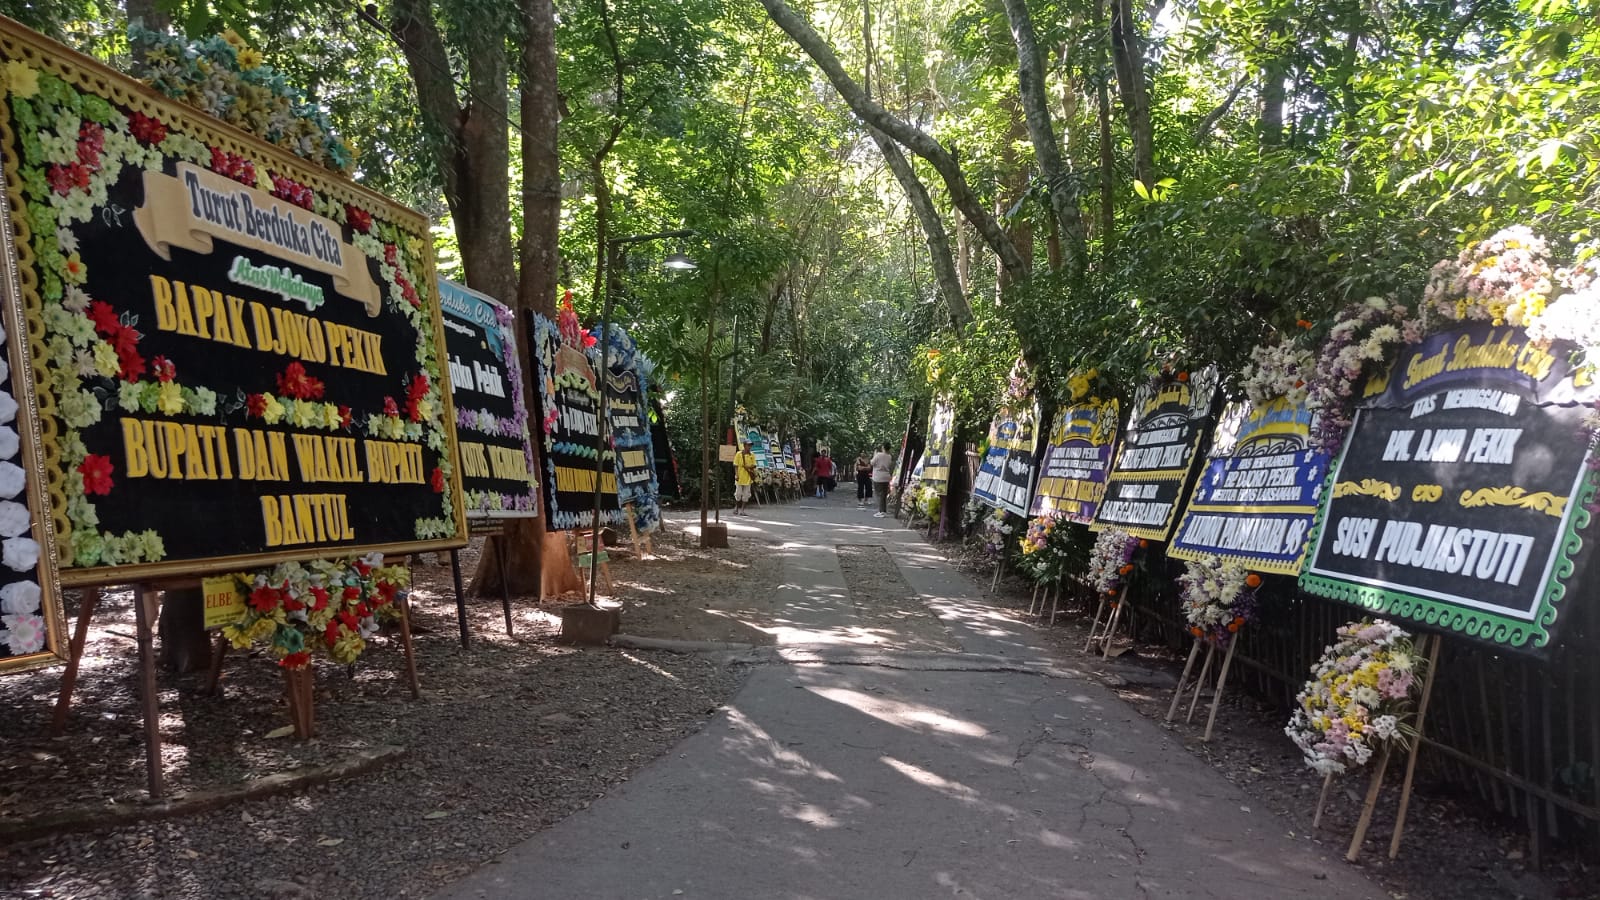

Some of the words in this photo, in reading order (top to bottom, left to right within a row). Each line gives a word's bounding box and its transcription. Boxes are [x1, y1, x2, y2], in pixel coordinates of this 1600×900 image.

[185, 169, 241, 232] Turut
[240, 192, 311, 255] Berduka
[310, 220, 342, 267] Cita
[150, 275, 252, 348] BAPAK
[249, 301, 327, 364] DJOKO
[323, 320, 388, 376] PEKIK
[1446, 329, 1519, 371] Berduka
[120, 417, 233, 480] BUPATI
[233, 427, 290, 482] DAN
[292, 433, 363, 483] WAKIL
[364, 439, 426, 485] BUPATI
[1465, 428, 1523, 464] PEKIK
[260, 493, 355, 547] BANTUL
[1281, 519, 1307, 555] 98
[1333, 516, 1379, 559] SUSI
[1375, 520, 1536, 587] PUDJIASTUTI
[206, 592, 233, 609] ELBE
